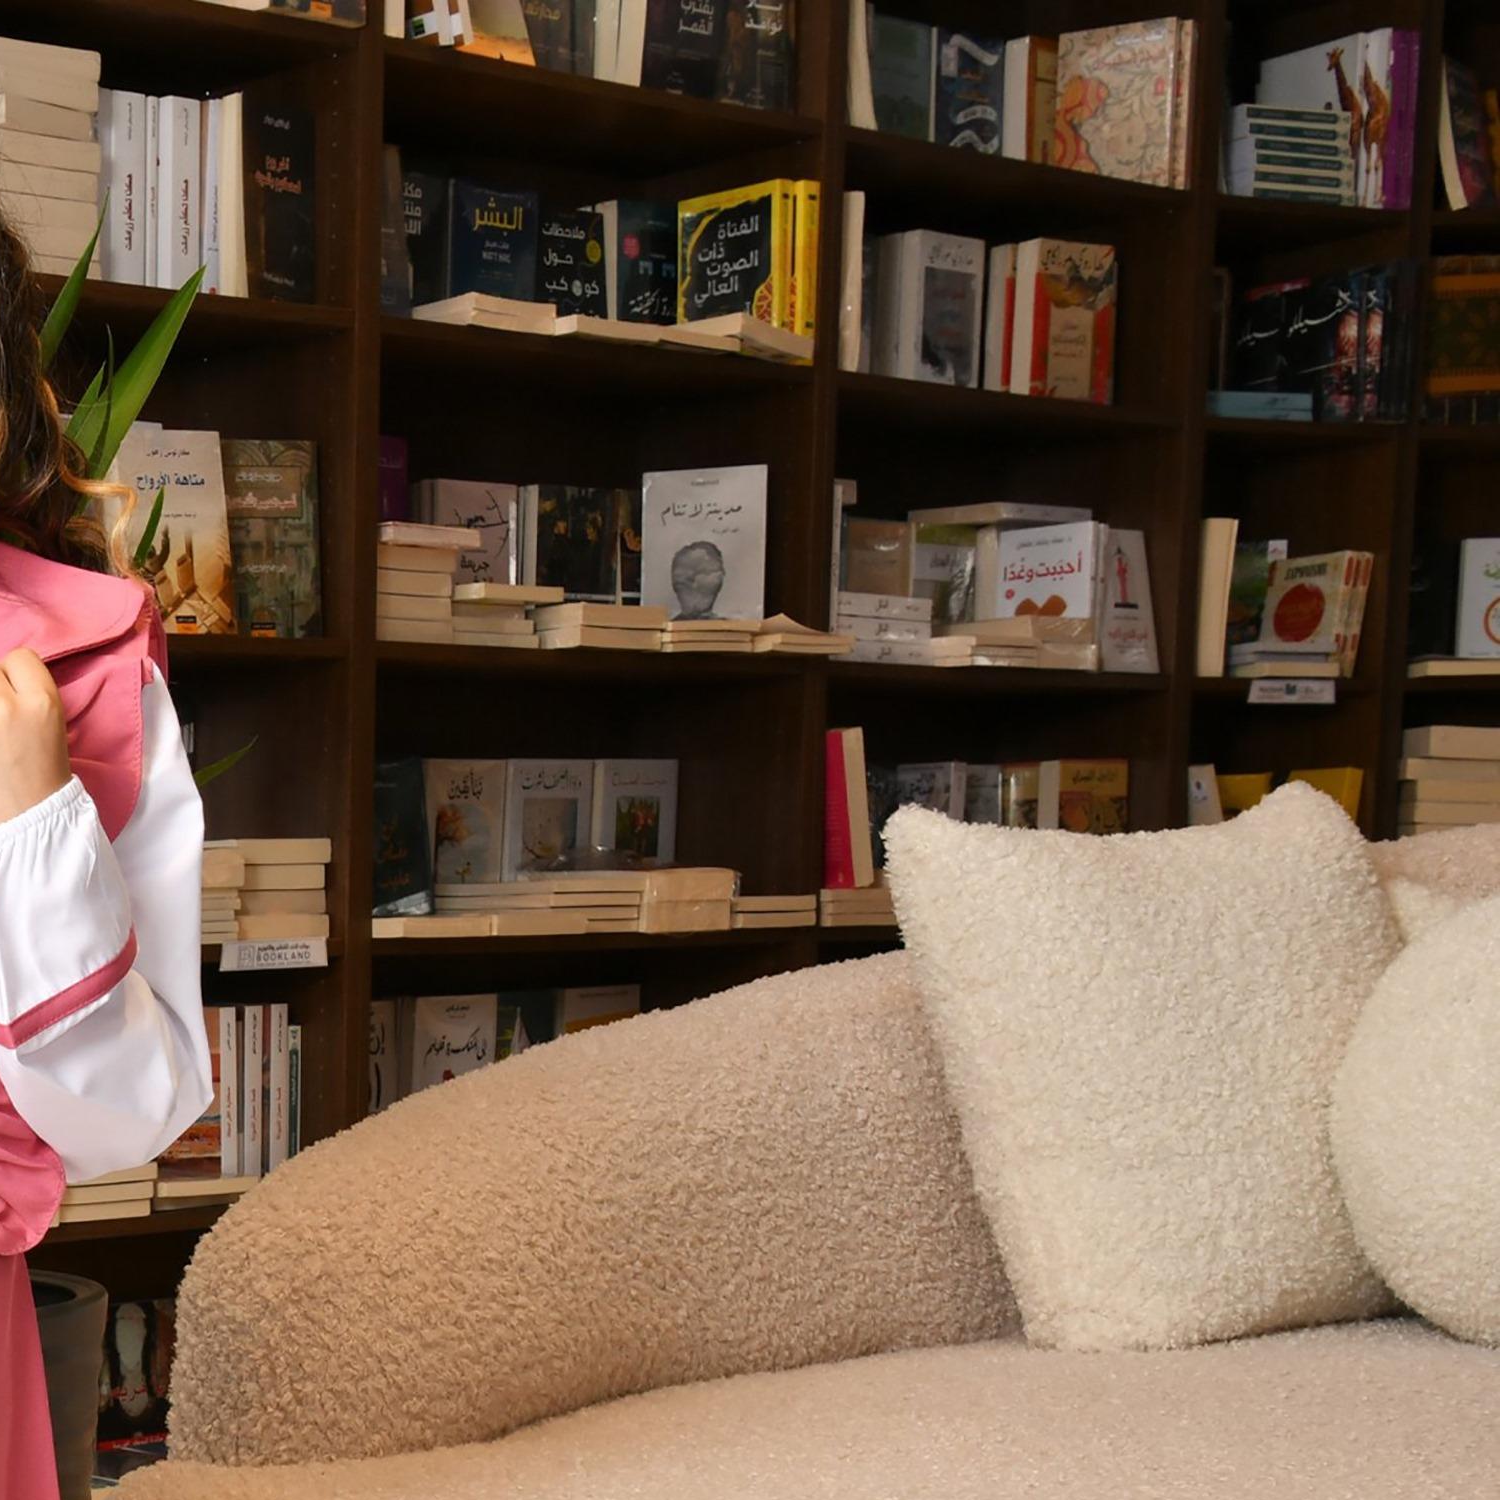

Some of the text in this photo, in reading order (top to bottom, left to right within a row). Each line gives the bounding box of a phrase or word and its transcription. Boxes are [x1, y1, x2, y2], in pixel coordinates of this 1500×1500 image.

[472, 196, 523, 236] البشر
[717, 215, 759, 240] الفتاة
[544, 248, 574, 267] حول
[697, 241, 725, 263] ذات
[706, 249, 759, 278] الصوت
[694, 276, 739, 307] العالي
[256, 950, 311, 962] BOOKLAND
